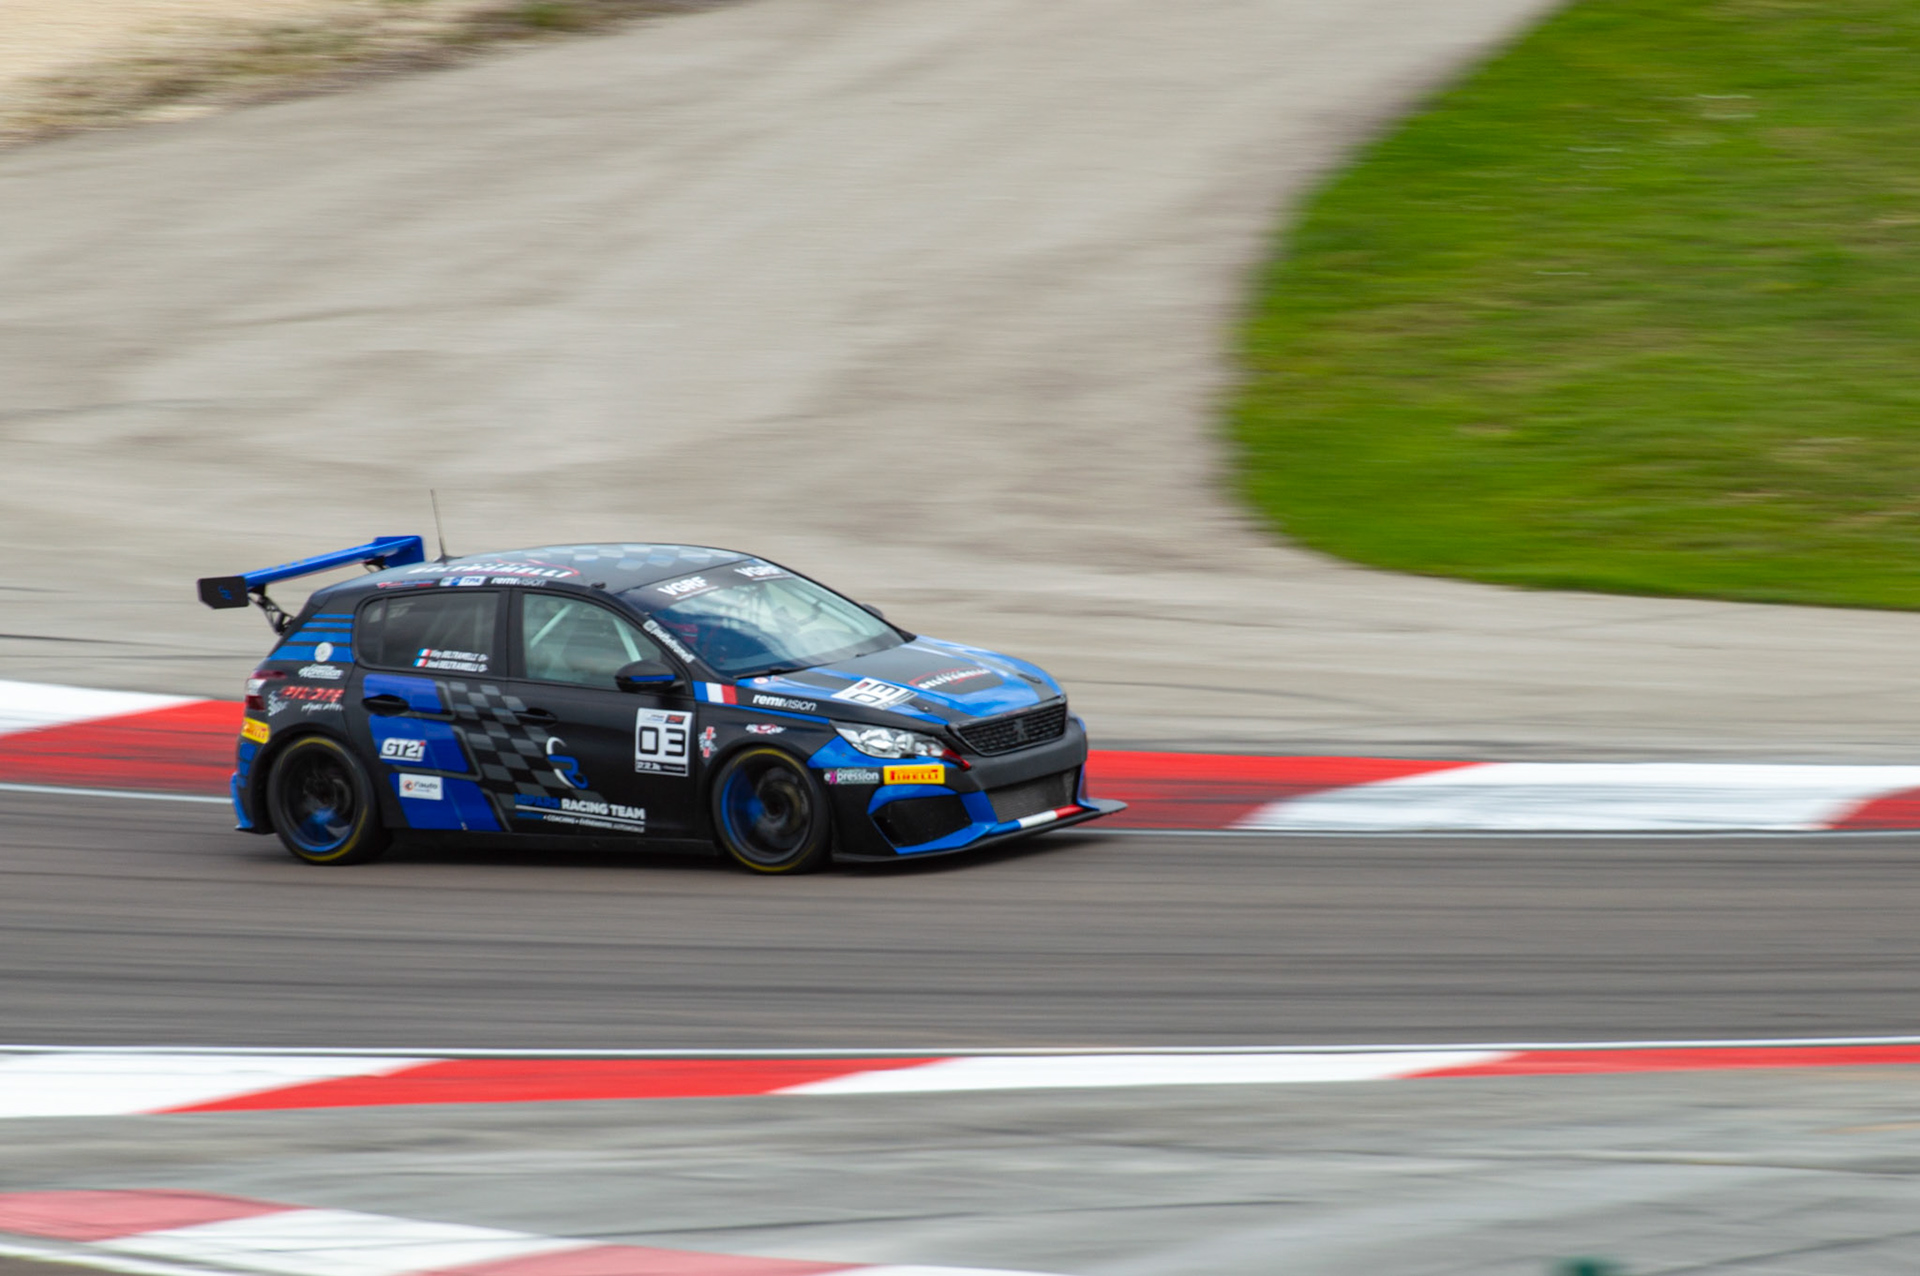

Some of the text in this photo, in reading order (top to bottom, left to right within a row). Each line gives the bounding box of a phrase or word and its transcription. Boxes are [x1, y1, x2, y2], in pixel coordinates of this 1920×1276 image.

[657, 576, 708, 596] VGRF
[752, 694, 818, 712] remivision
[382, 737, 427, 759] GT2i
[638, 726, 687, 758] 03
[561, 798, 609, 816] RACING
[609, 804, 646, 820] TEAM
